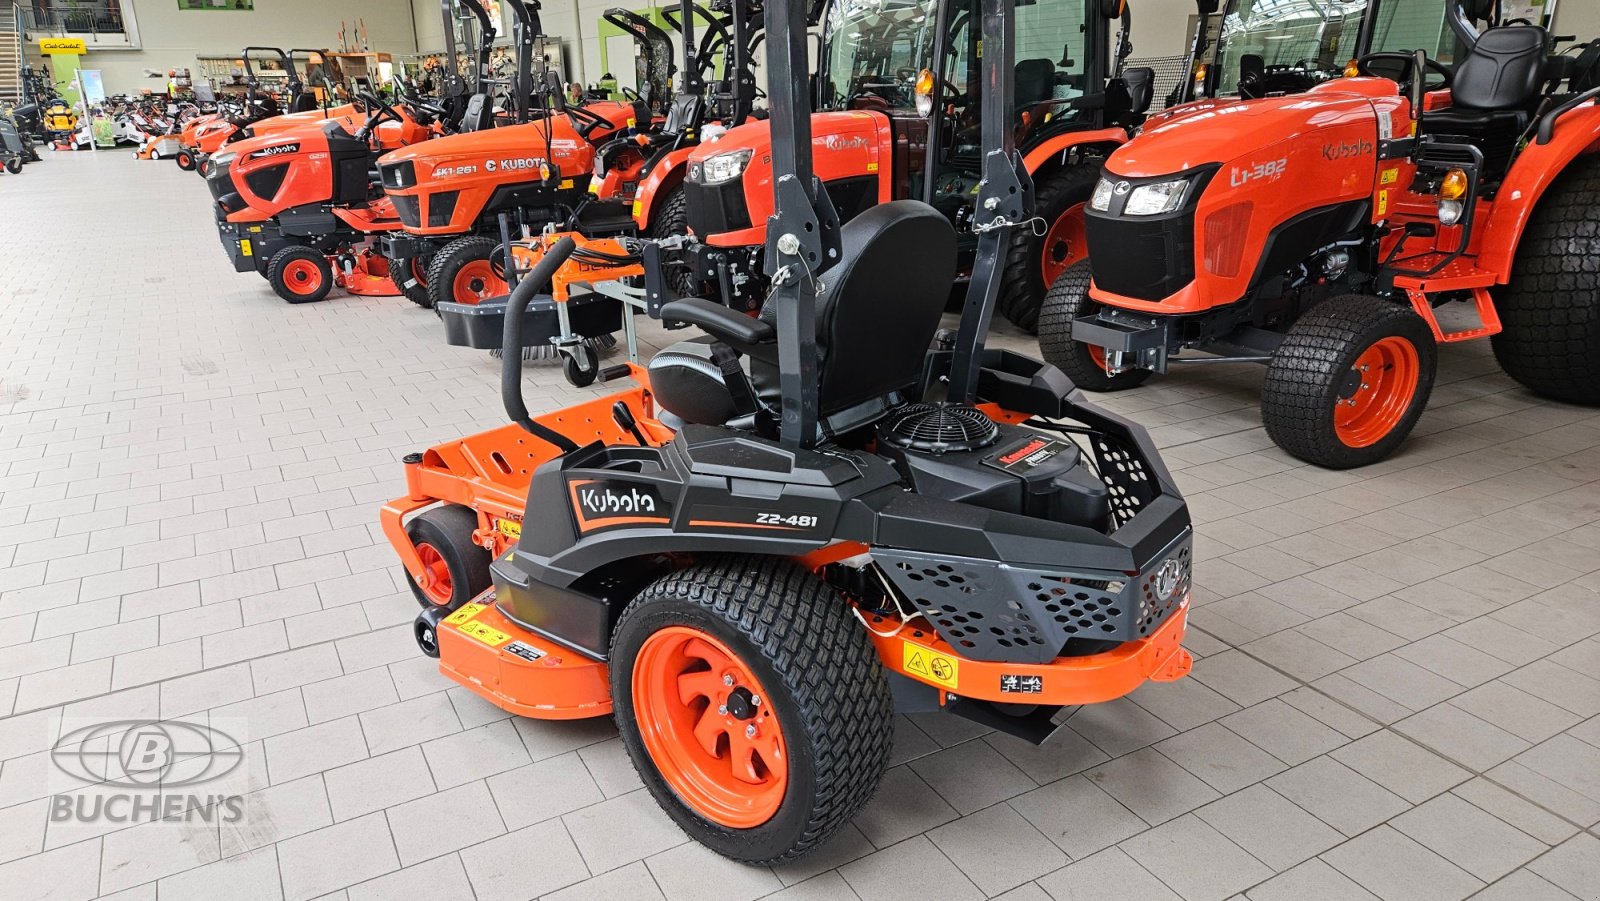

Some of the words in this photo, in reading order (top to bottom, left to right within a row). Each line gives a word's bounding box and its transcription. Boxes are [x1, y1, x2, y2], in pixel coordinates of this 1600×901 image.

[264, 145, 297, 155] Kubota
[1322, 138, 1373, 160] Kubota
[1230, 158, 1288, 188] L1-382
[581, 488, 656, 512] Kubota
[755, 512, 818, 527] Z2-481
